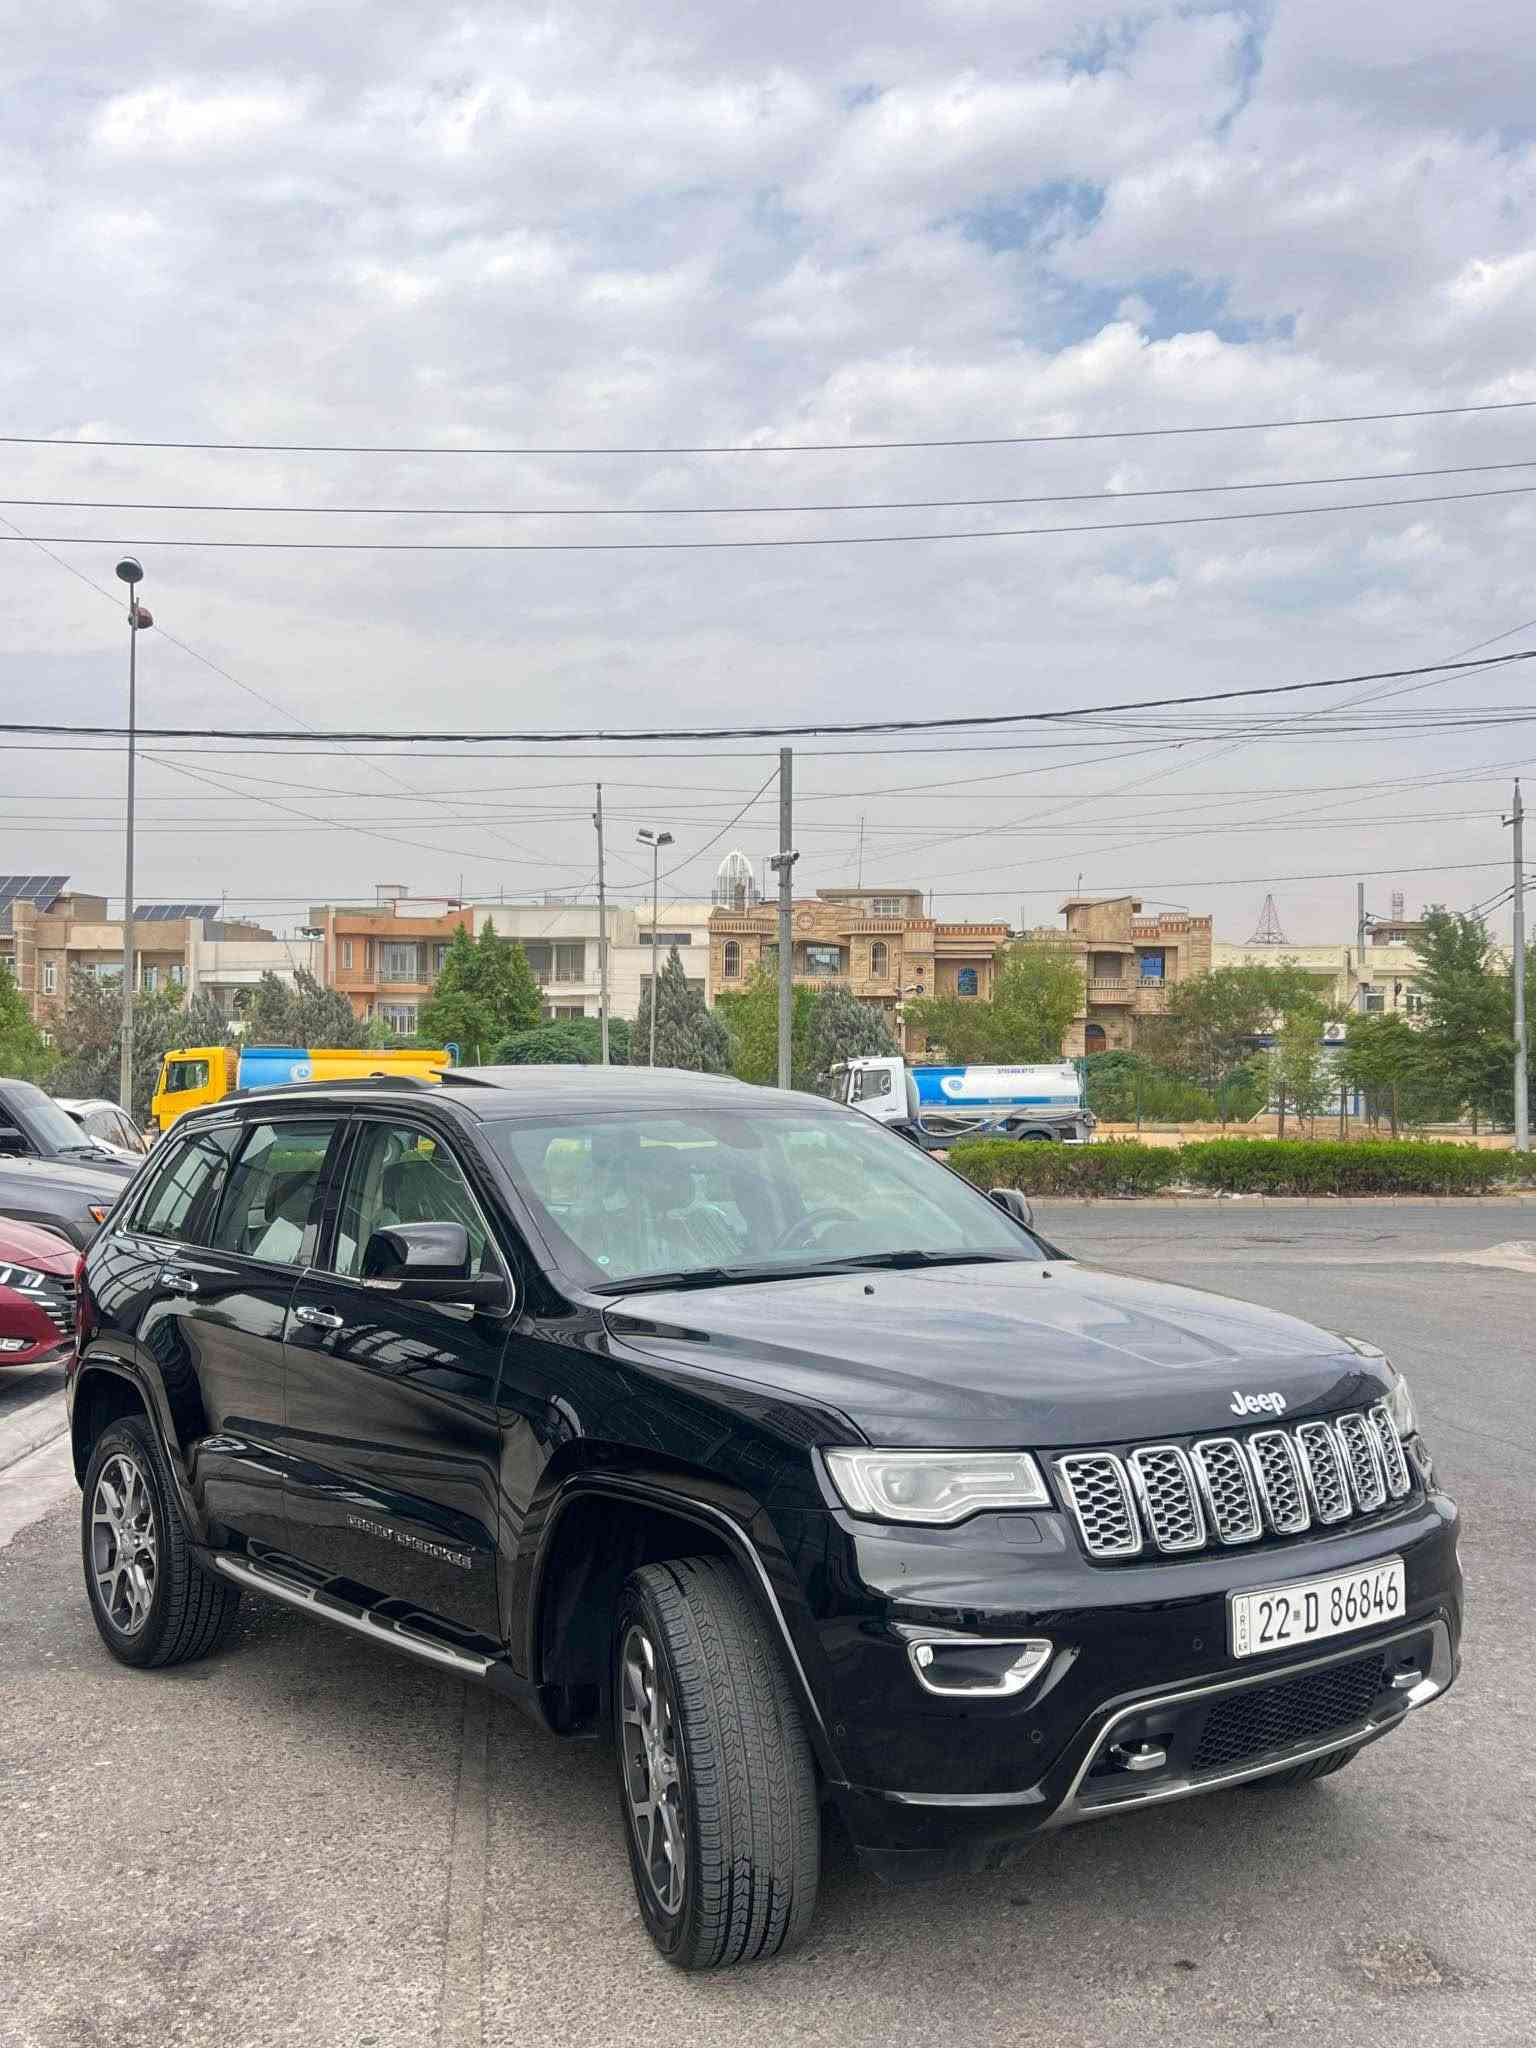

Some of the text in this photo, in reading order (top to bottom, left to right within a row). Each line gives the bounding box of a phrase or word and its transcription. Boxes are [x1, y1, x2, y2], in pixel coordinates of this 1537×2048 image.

[1230, 1391, 1287, 1416] Jeep
[1259, 1571, 1399, 1643] 22 D 86846
